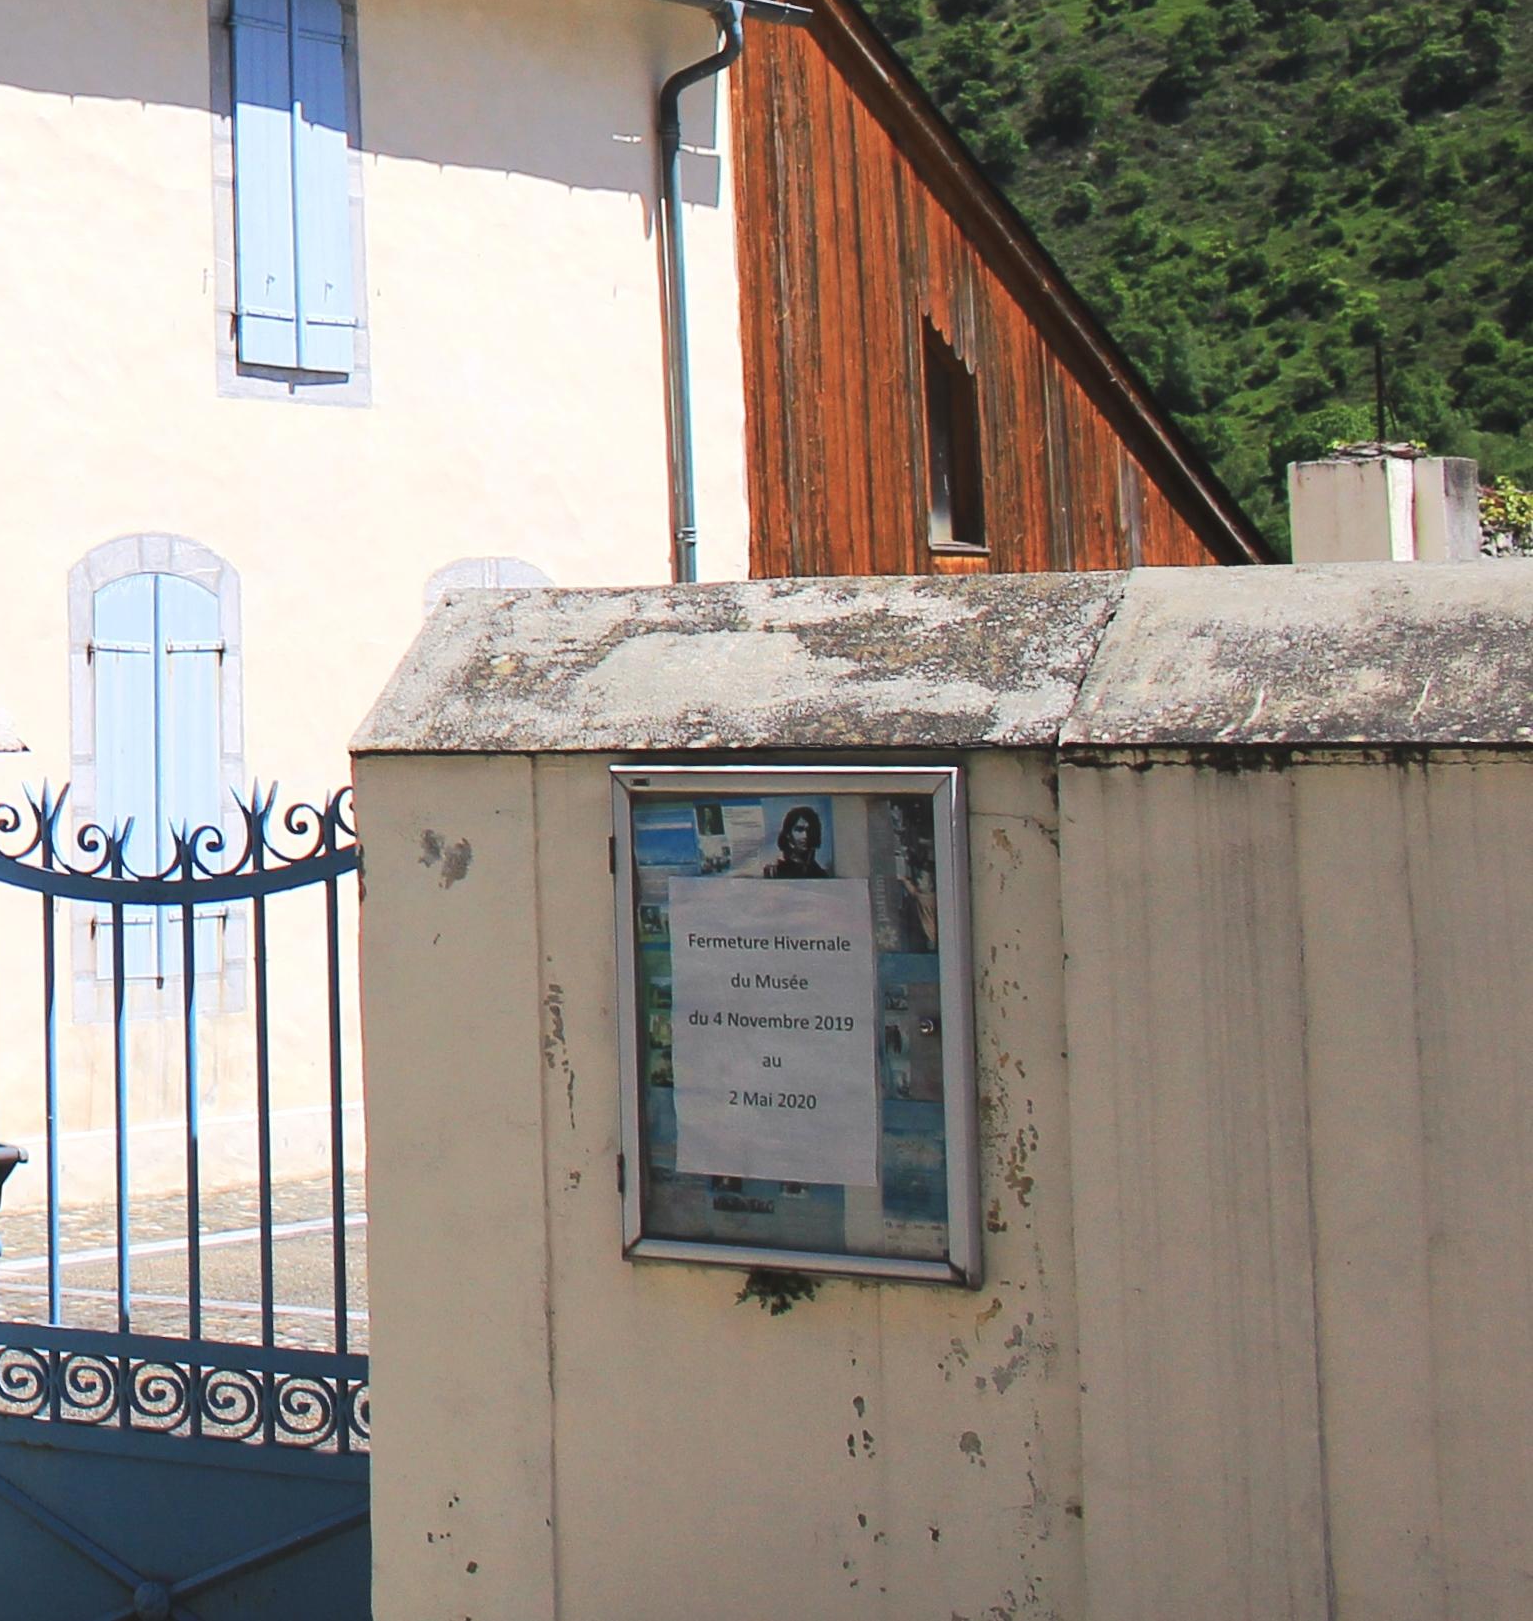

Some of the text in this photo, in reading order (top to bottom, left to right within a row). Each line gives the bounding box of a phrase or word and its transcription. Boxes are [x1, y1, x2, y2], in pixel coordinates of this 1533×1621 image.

[688, 933, 851, 951] Fermeture Hivernale
[730, 973, 809, 990] du Musée
[688, 1010, 854, 1032] du 4 Novembre 2019
[762, 1055, 782, 1068] au
[728, 1090, 817, 1110] 2 Mai 2020
